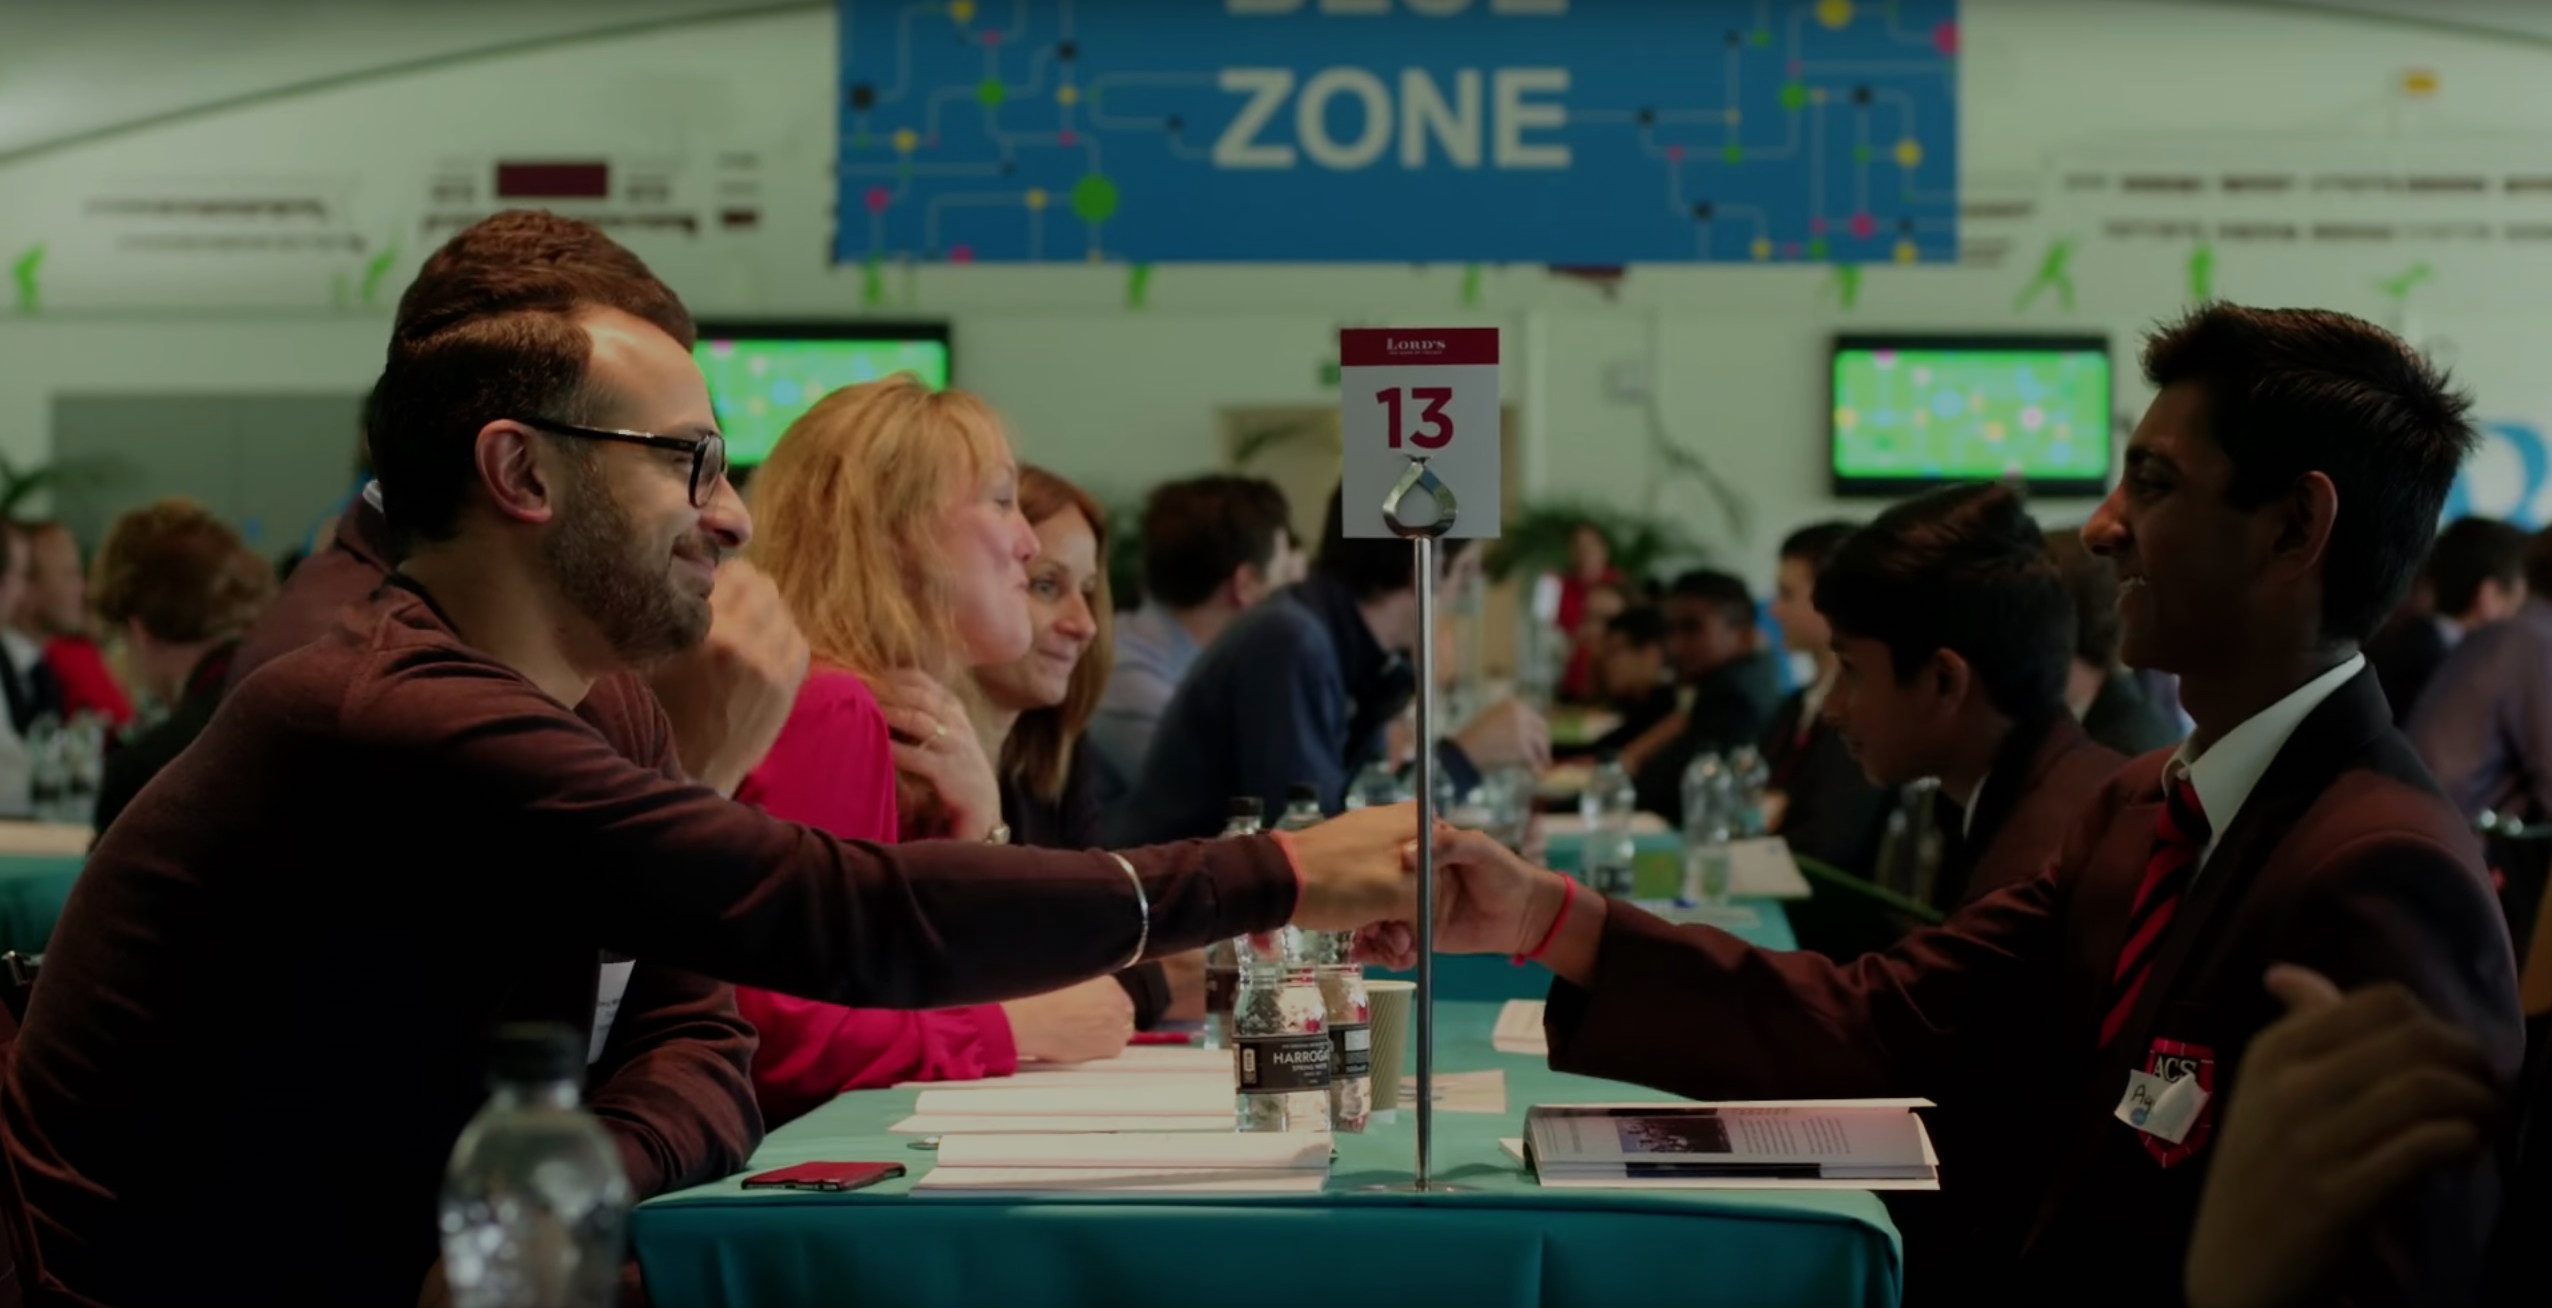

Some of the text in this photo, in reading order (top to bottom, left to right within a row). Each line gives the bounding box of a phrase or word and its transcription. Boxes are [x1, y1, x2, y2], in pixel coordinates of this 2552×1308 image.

[1212, 65, 1572, 170] ZONE
[1376, 387, 1453, 449] 13
[2152, 1054, 2198, 1083] ACS
